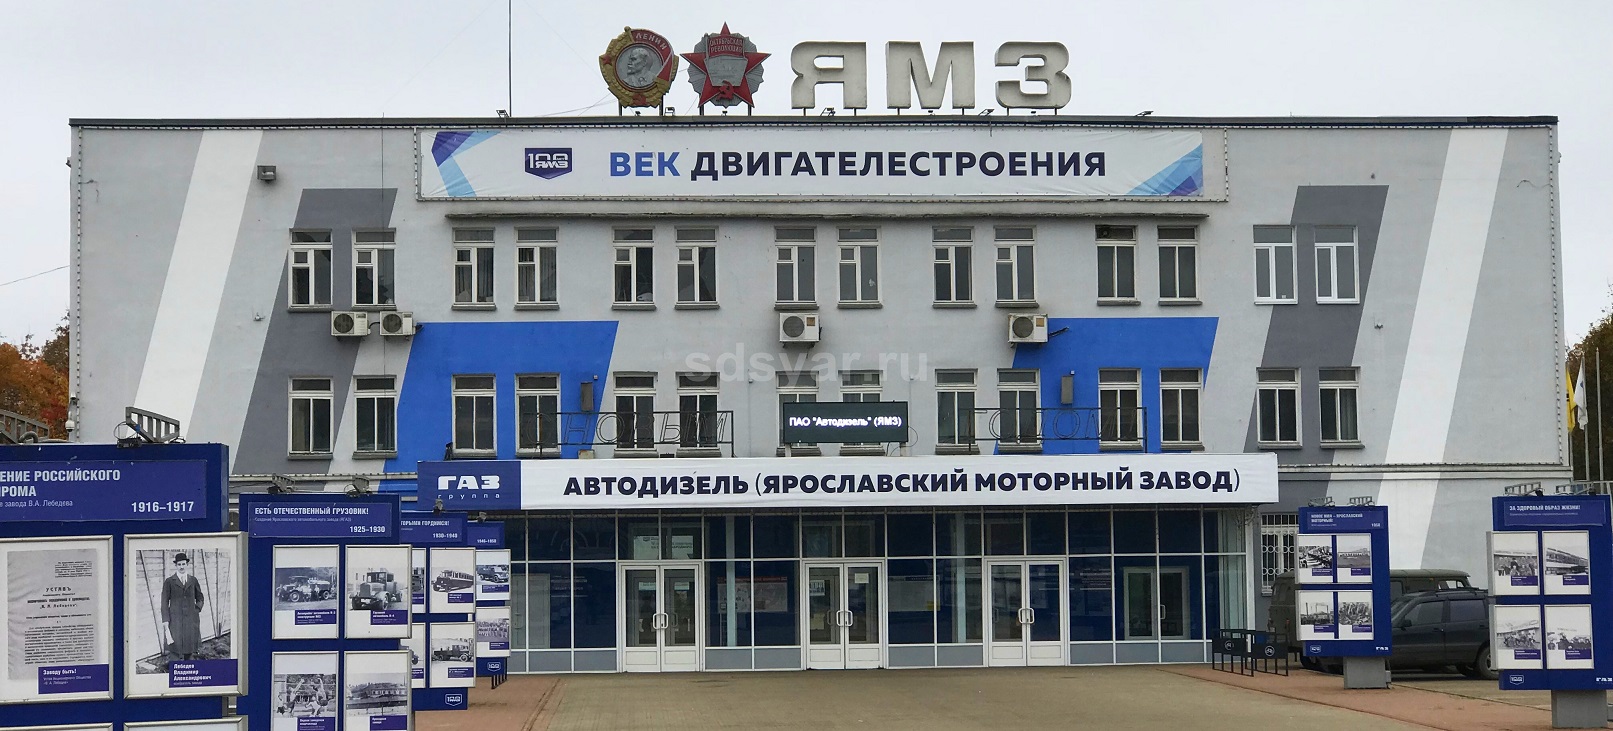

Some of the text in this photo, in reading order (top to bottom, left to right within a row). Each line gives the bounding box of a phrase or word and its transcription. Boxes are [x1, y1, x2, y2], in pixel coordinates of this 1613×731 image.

[636, 33, 667, 50] ЛЕНИН
[790, 41, 1072, 109] ЯМЗ
[610, 152, 1106, 181] ВЕК ДВИГАТЕЛЕСТРОЕНИЯ
[789, 416, 902, 427] ПАО "Автодизель" (ЯМЗ)
[34, 468, 121, 481] РОССИЙСКОГО
[438, 475, 500, 490] ГАЗ
[563, 467, 1241, 498] АВТОДИЗЕЛЬ (ЯРОСЛАВСКИЙ МОТОРНЫЙ ЗАВОД)
[0, 485, 37, 497] РОМА
[273, 507, 331, 515] ОТЕЧЕСТВЕННЫЙ
[332, 507, 369, 515] ГРУЗОВИК!
